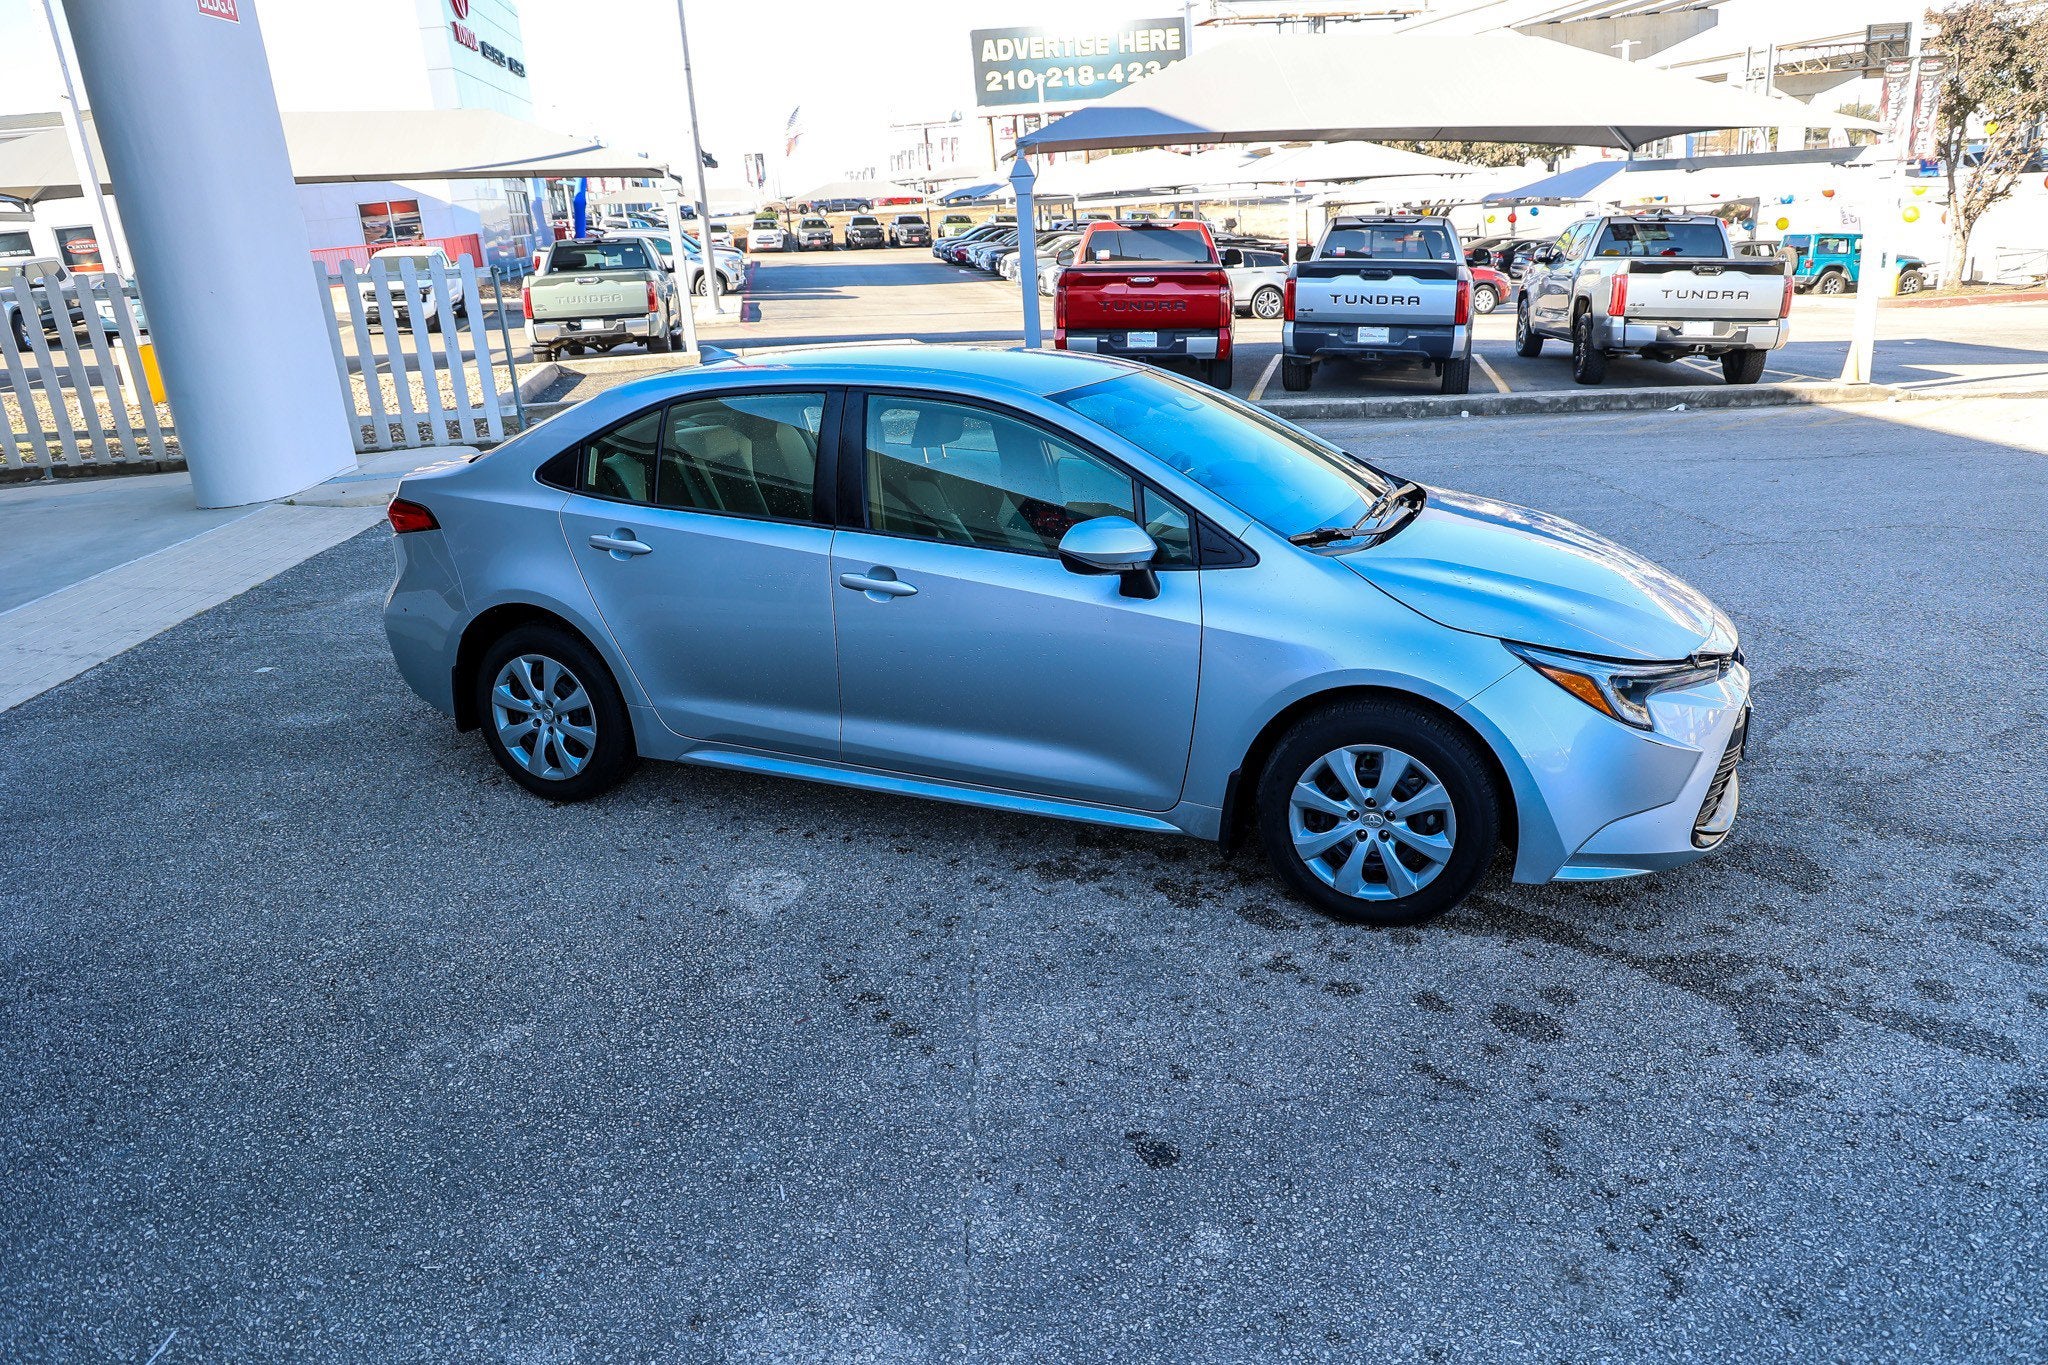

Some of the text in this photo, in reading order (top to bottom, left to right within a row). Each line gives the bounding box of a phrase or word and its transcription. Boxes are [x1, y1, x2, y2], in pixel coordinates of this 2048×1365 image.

[981, 28, 1181, 63] ADVERTISE HERE
[985, 59, 1179, 92] 210-218-423
[555, 293, 624, 305] TUNDRA
[1329, 294, 1421, 305] TUNDRA
[1661, 289, 1750, 300] TUNDRA
[1098, 300, 1187, 311] TUNDRA
